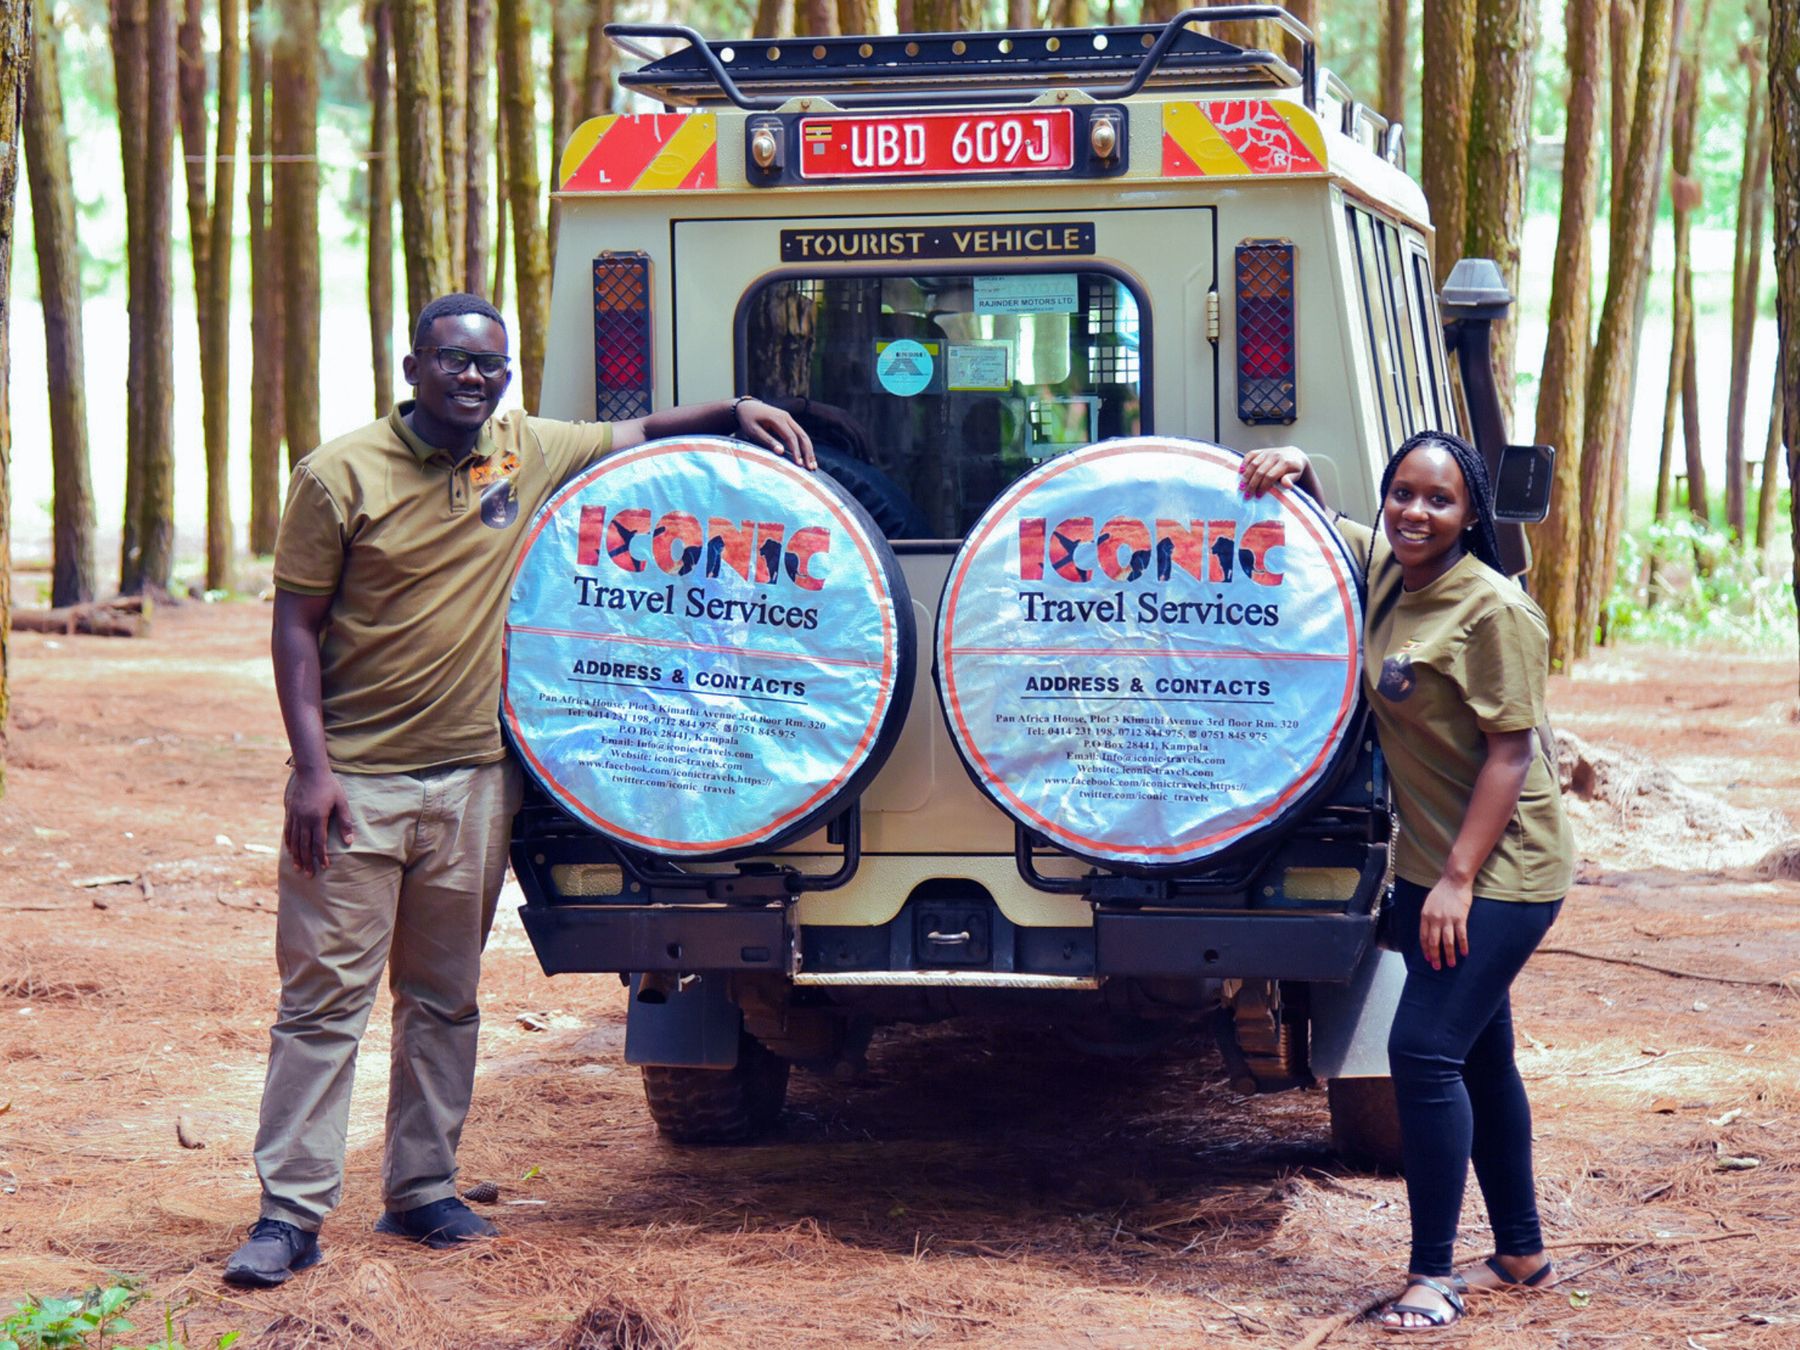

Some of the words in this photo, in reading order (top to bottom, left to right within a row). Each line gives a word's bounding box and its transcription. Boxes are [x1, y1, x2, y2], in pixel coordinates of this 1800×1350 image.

[851, 124, 926, 167] UBD
[952, 119, 1051, 164] 609J
[1274, 152, 1287, 166] R
[599, 170, 611, 183] L
[796, 233, 925, 256] TOURIST
[952, 229, 1080, 252] VEHICLE
[979, 299, 1019, 307] RAJINDER
[1021, 298, 1056, 306] MOTORS
[1058, 297, 1073, 305] LTD
[577, 505, 831, 591] ICONIC
[1019, 516, 1286, 586] ICONIC
[574, 576, 674, 614] Travel
[685, 587, 819, 630] Services
[1019, 591, 1126, 623] Travel
[1138, 591, 1279, 626] Services
[573, 659, 662, 682] ADDRESS
[671, 669, 685, 684] &
[695, 671, 806, 697] CONTACTS
[1025, 676, 1119, 692] ADDRESS
[1130, 677, 1143, 692] &
[1155, 678, 1271, 696] CONTACTS
[539, 693, 557, 702] Pan
[560, 695, 589, 706] Africa
[592, 698, 625, 710] House,
[628, 702, 648, 711] Plot
[659, 705, 699, 716] Kimathi
[703, 710, 737, 720] Avenue
[739, 713, 757, 722] 3rd
[785, 718, 806, 728] Rm.
[808, 720, 826, 730] 320
[996, 714, 1015, 723] Pan
[1018, 714, 1049, 723] Africa
[1053, 714, 1087, 724] House,
[1090, 715, 1110, 723] Plot
[1113, 715, 1119, 723] 3
[1167, 716, 1203, 726] Avenue
[1207, 717, 1225, 726] 3rd
[1228, 718, 1252, 728] floor
[1256, 719, 1277, 728] Rm.
[1280, 720, 1299, 729] 320
[567, 709, 584, 718] Tel:
[587, 710, 609, 719] 0414
[612, 712, 627, 721] 231
[632, 714, 652, 724] 198,
[655, 716, 676, 726] 0712
[679, 719, 697, 729] 844
[732, 724, 755, 734] 0751
[758, 727, 776, 737] 845
[778, 729, 796, 739] 975
[1026, 727, 1045, 735] Tel:
[1047, 727, 1071, 735] 0414
[1075, 727, 1091, 736] 231
[1095, 728, 1115, 737] 198,
[1118, 728, 1142, 737] 0712
[1145, 728, 1162, 737] 844
[1200, 730, 1224, 739] 0751
[1228, 731, 1246, 740] 845
[1249, 731, 1268, 741] 975
[601, 735, 634, 747] Email:
[620, 725, 636, 735] P.O
[640, 727, 657, 737] Box
[695, 732, 739, 745] Kampala
[1084, 740, 1101, 748] P.O
[1104, 740, 1123, 749] Box
[1126, 740, 1158, 751] 28441,
[1161, 742, 1208, 753] Kampala
[610, 749, 652, 761] Website:
[655, 753, 743, 771] iconic-travels.com
[1066, 751, 1098, 760] Email:
[1102, 752, 1225, 765] Info@iconic-travels.com
[1077, 765, 1119, 775] Website:
[1122, 765, 1214, 777] iconic-travels.com
